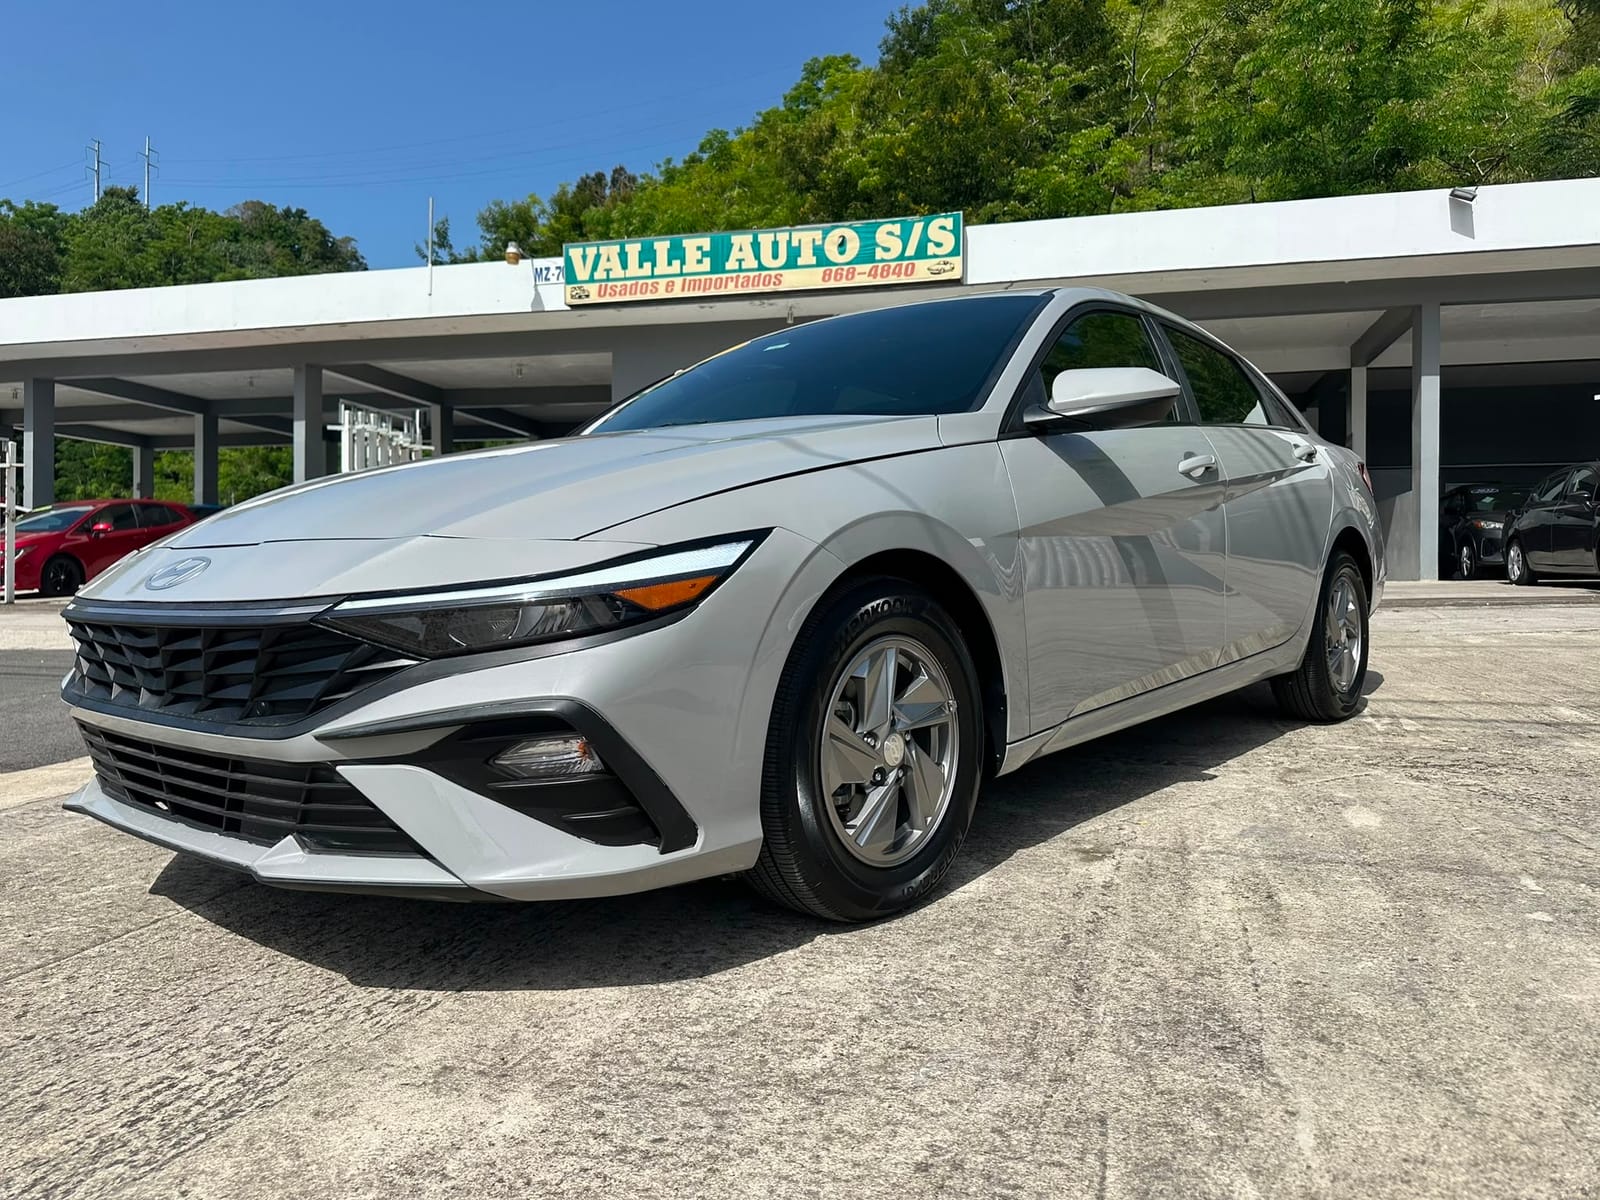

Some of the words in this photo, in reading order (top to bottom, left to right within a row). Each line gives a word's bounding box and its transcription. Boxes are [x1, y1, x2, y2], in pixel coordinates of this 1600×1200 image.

[568, 237, 711, 281] VALLE
[725, 227, 861, 271] AUTO
[874, 217, 956, 261] S/S
[597, 281, 660, 298] Usados
[664, 280, 675, 294] e
[681, 272, 783, 294] Importados
[821, 262, 916, 283] 868-4840
